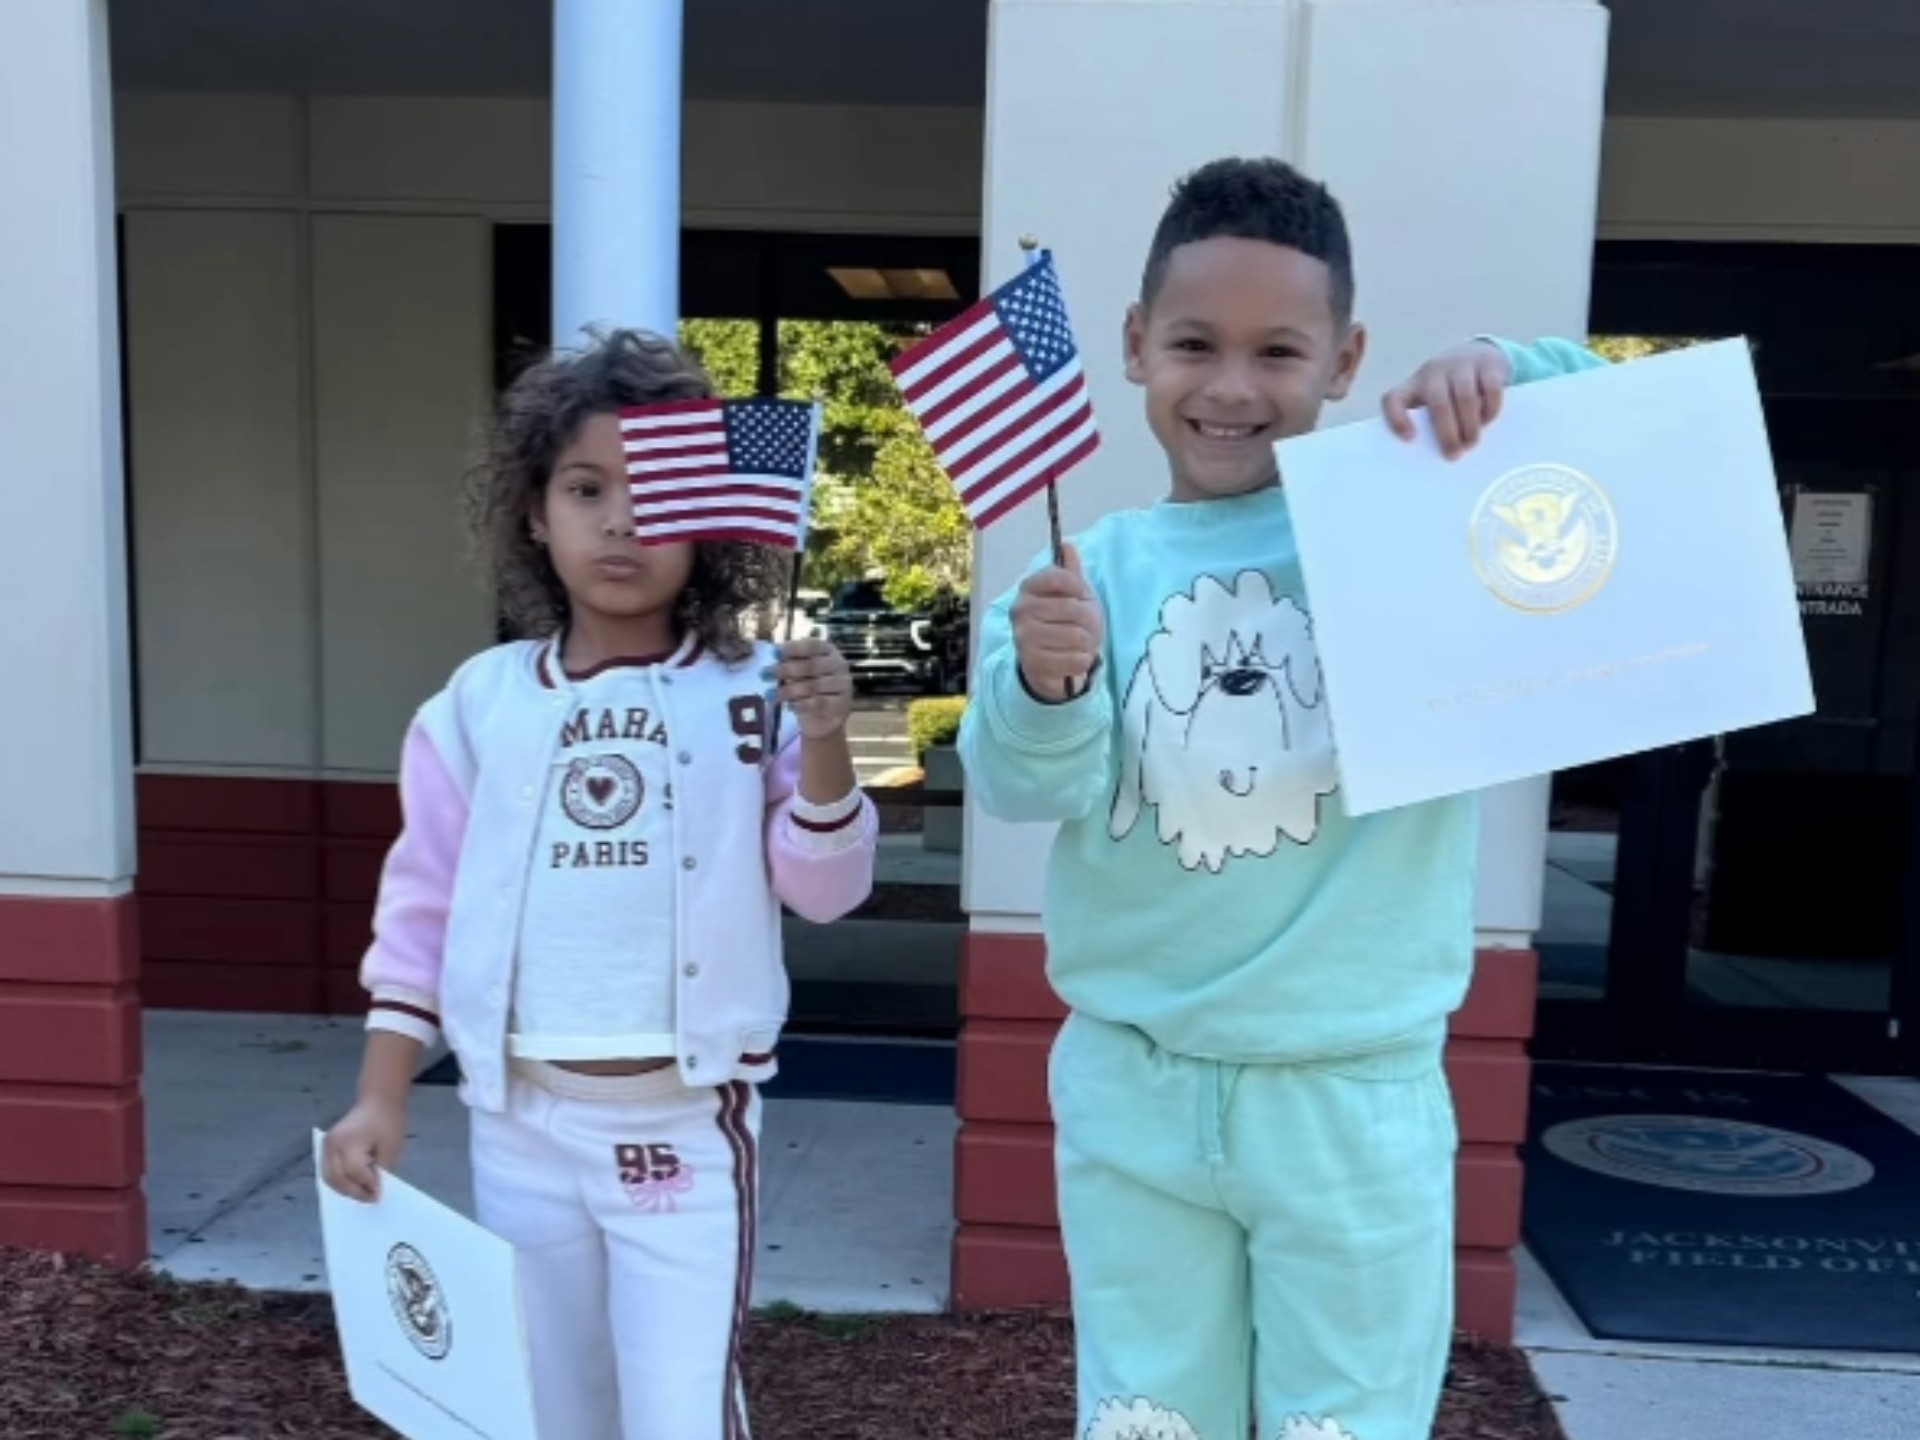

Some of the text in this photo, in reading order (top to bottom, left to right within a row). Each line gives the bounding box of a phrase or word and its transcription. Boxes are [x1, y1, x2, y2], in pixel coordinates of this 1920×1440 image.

[549, 840, 649, 869] PARIS
[613, 1143, 681, 1185] 95
[1599, 1229, 1920, 1255] JACKSONVI
[1628, 1249, 1804, 1270] FIELD
